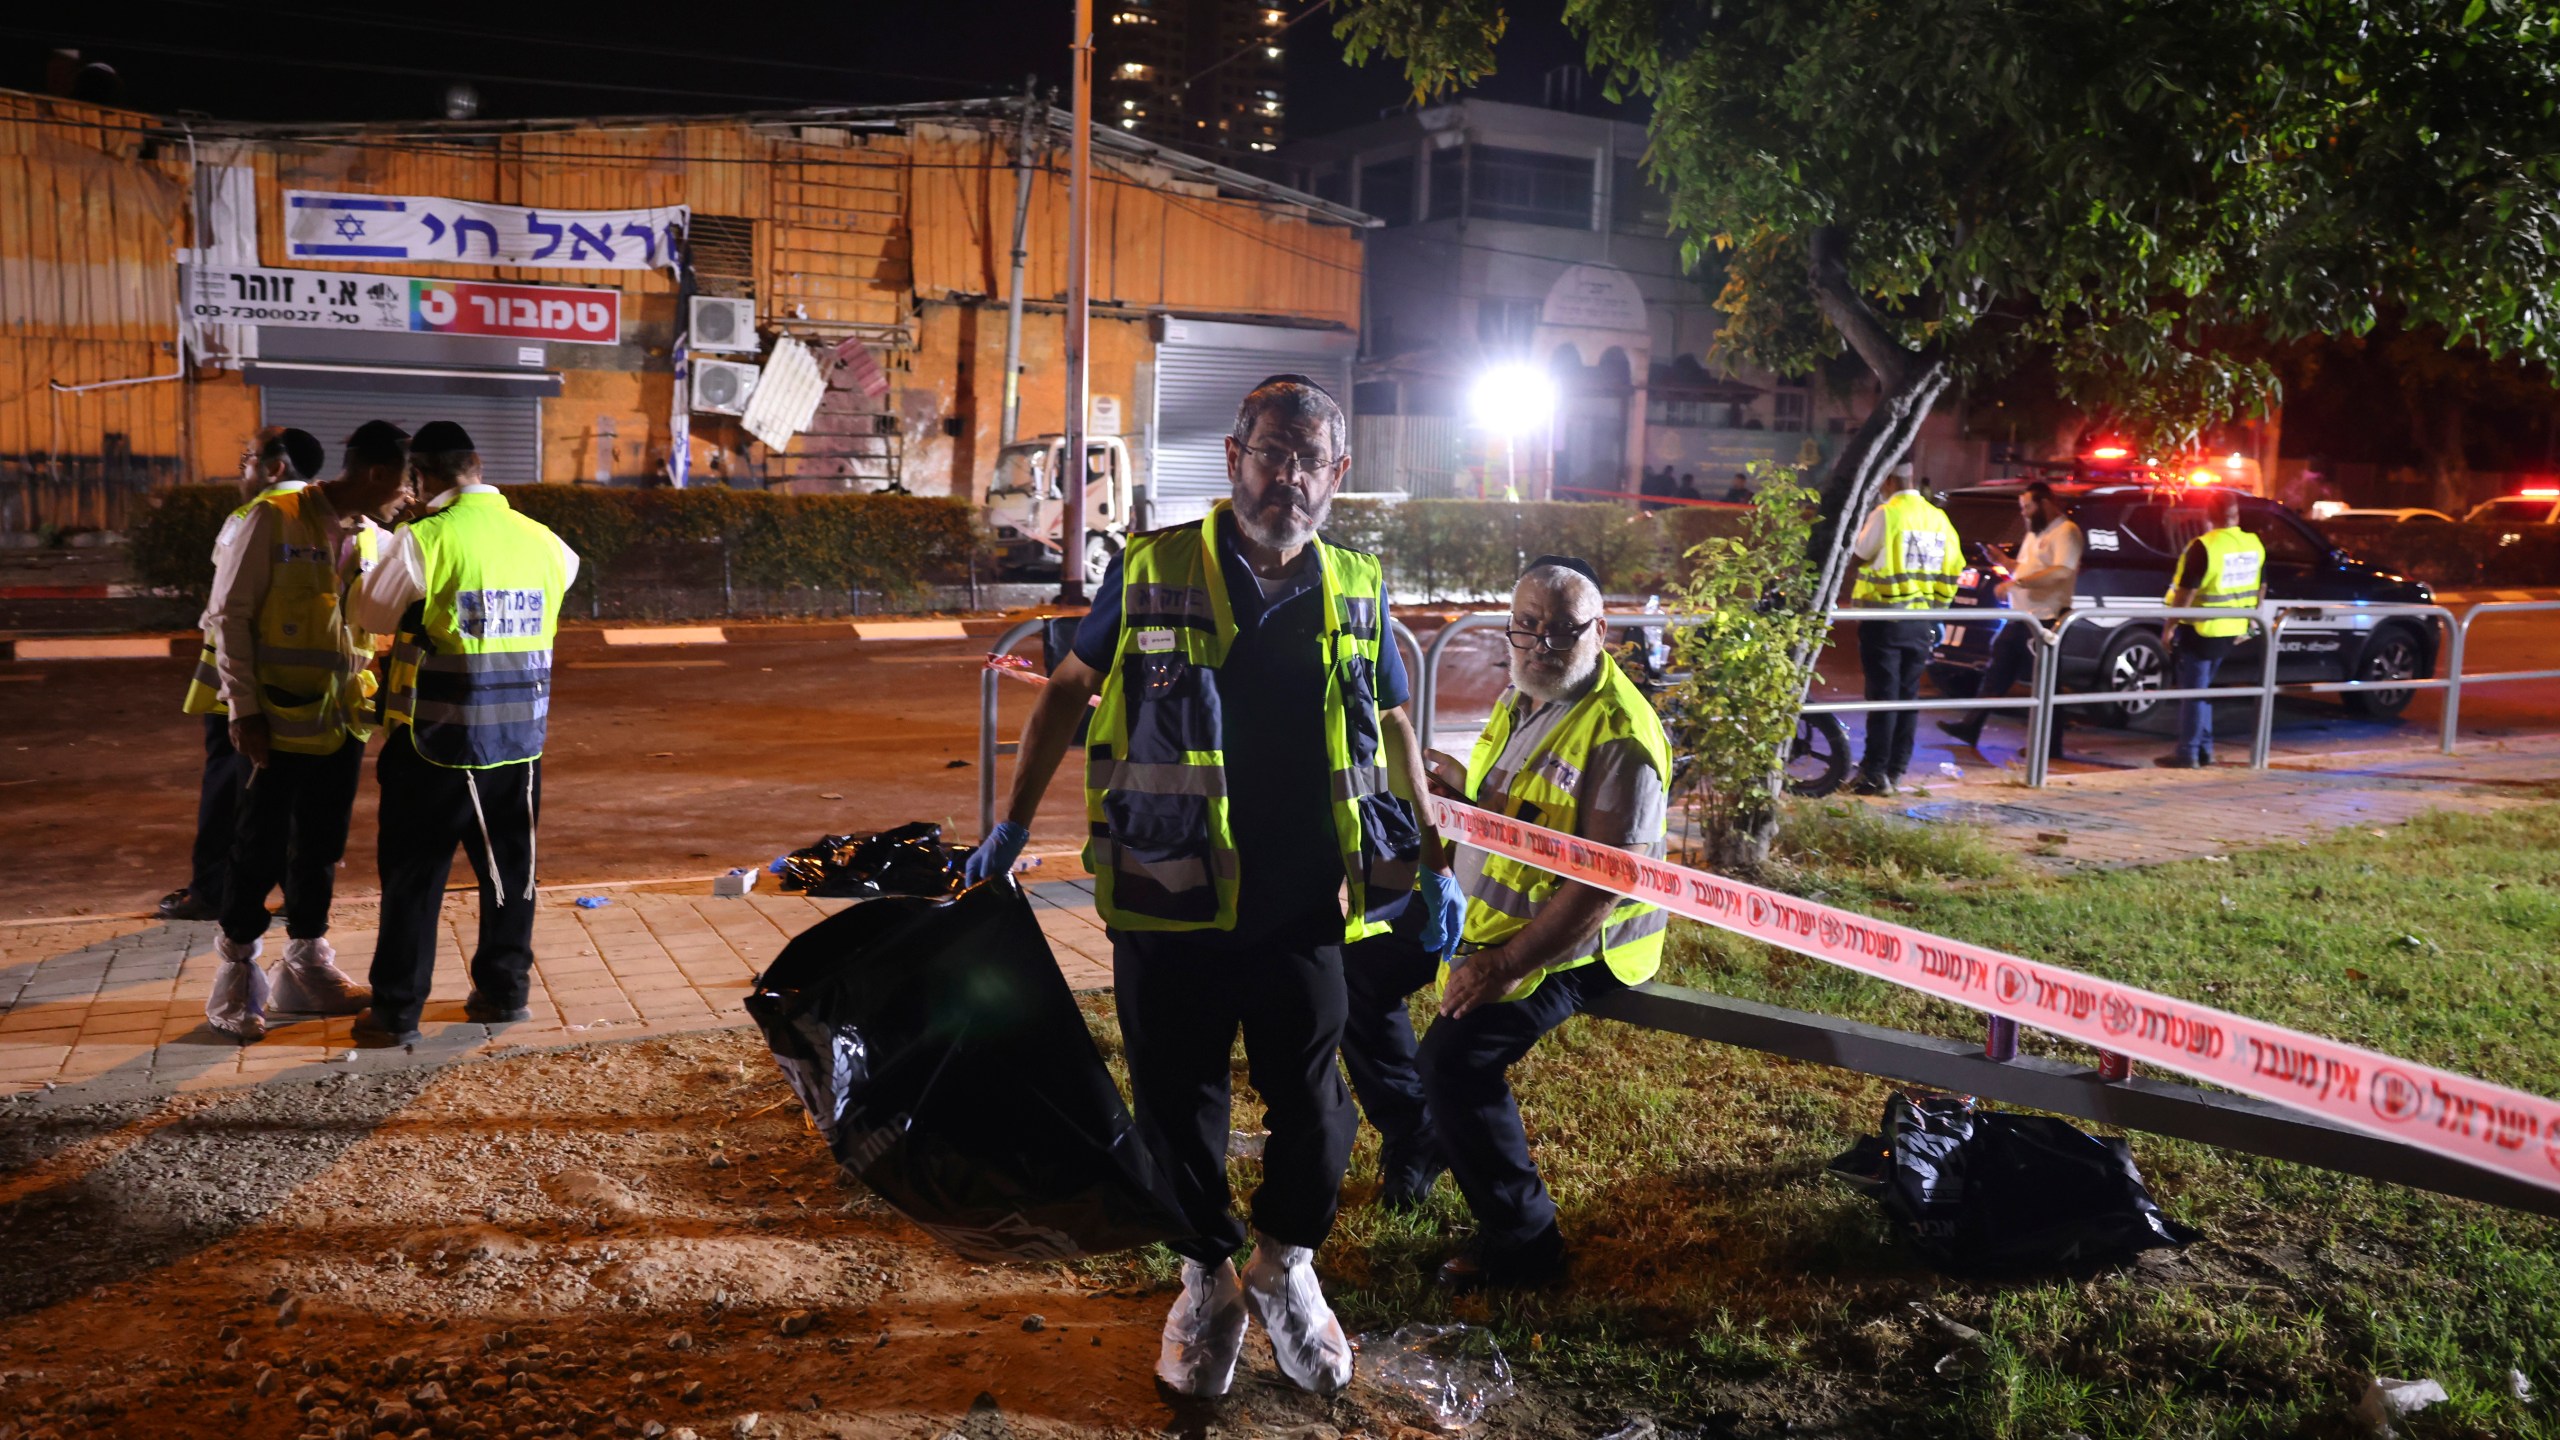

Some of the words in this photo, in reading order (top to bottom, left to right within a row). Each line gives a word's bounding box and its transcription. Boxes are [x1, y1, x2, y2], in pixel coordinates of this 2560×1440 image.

[420, 212, 498, 258] חי
[230, 273, 294, 303] זוהר
[194, 304, 320, 322] 03-7300027
[470, 295, 610, 332] טמבור
[1640, 864, 1681, 896] משטרת
[1691, 879, 1724, 907] מעבר
[1723, 889, 1742, 918] אין
[1769, 896, 1816, 936] ישראל
[1844, 922, 1901, 963] משטרת
[1917, 943, 1962, 981] מעבר
[1961, 957, 1988, 992] אין
[2030, 970, 2096, 1019] ישראל
[2137, 1006, 2224, 1059] משטרת
[2249, 1037, 2318, 1088] מעבר
[2318, 1058, 2360, 1102] אין
[2431, 1079, 2537, 1150] ישראל
